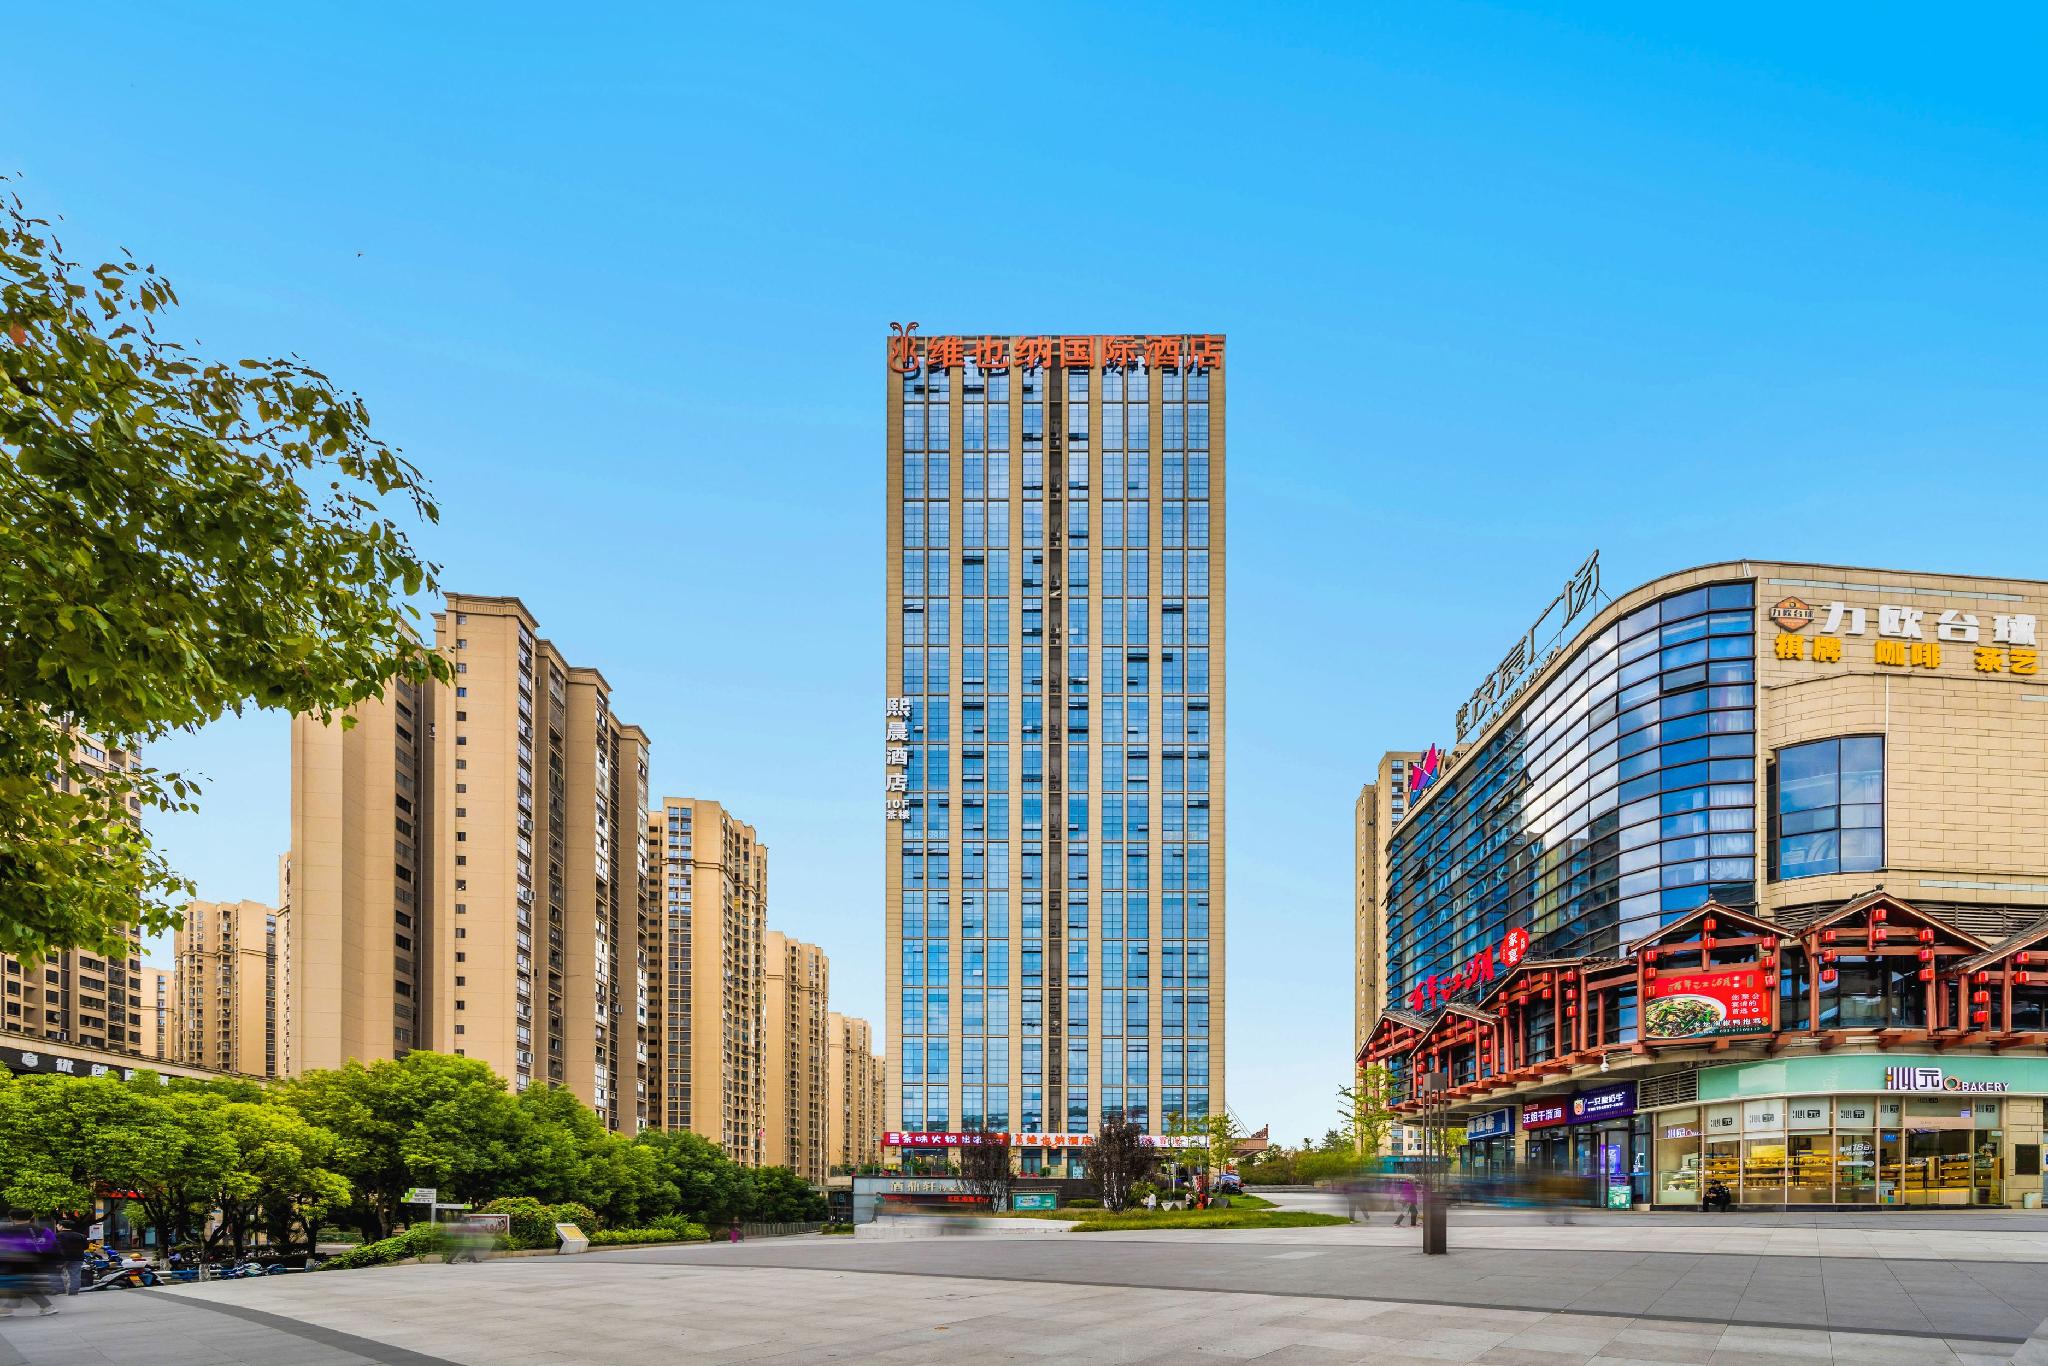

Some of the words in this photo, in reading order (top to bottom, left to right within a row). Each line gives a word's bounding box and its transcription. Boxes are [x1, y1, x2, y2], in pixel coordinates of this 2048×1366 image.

[927, 335, 1224, 369] 维也纳国际酒店
[1821, 601, 2036, 645] 力欧台球
[1775, 634, 1840, 662] 棋牌
[1875, 640, 1940, 668] 咖啡
[1974, 647, 2037, 674] 茶艺
[886, 697, 911, 792] 熙晨酒店
[1961, 1081, 2010, 1092] BAKERY
